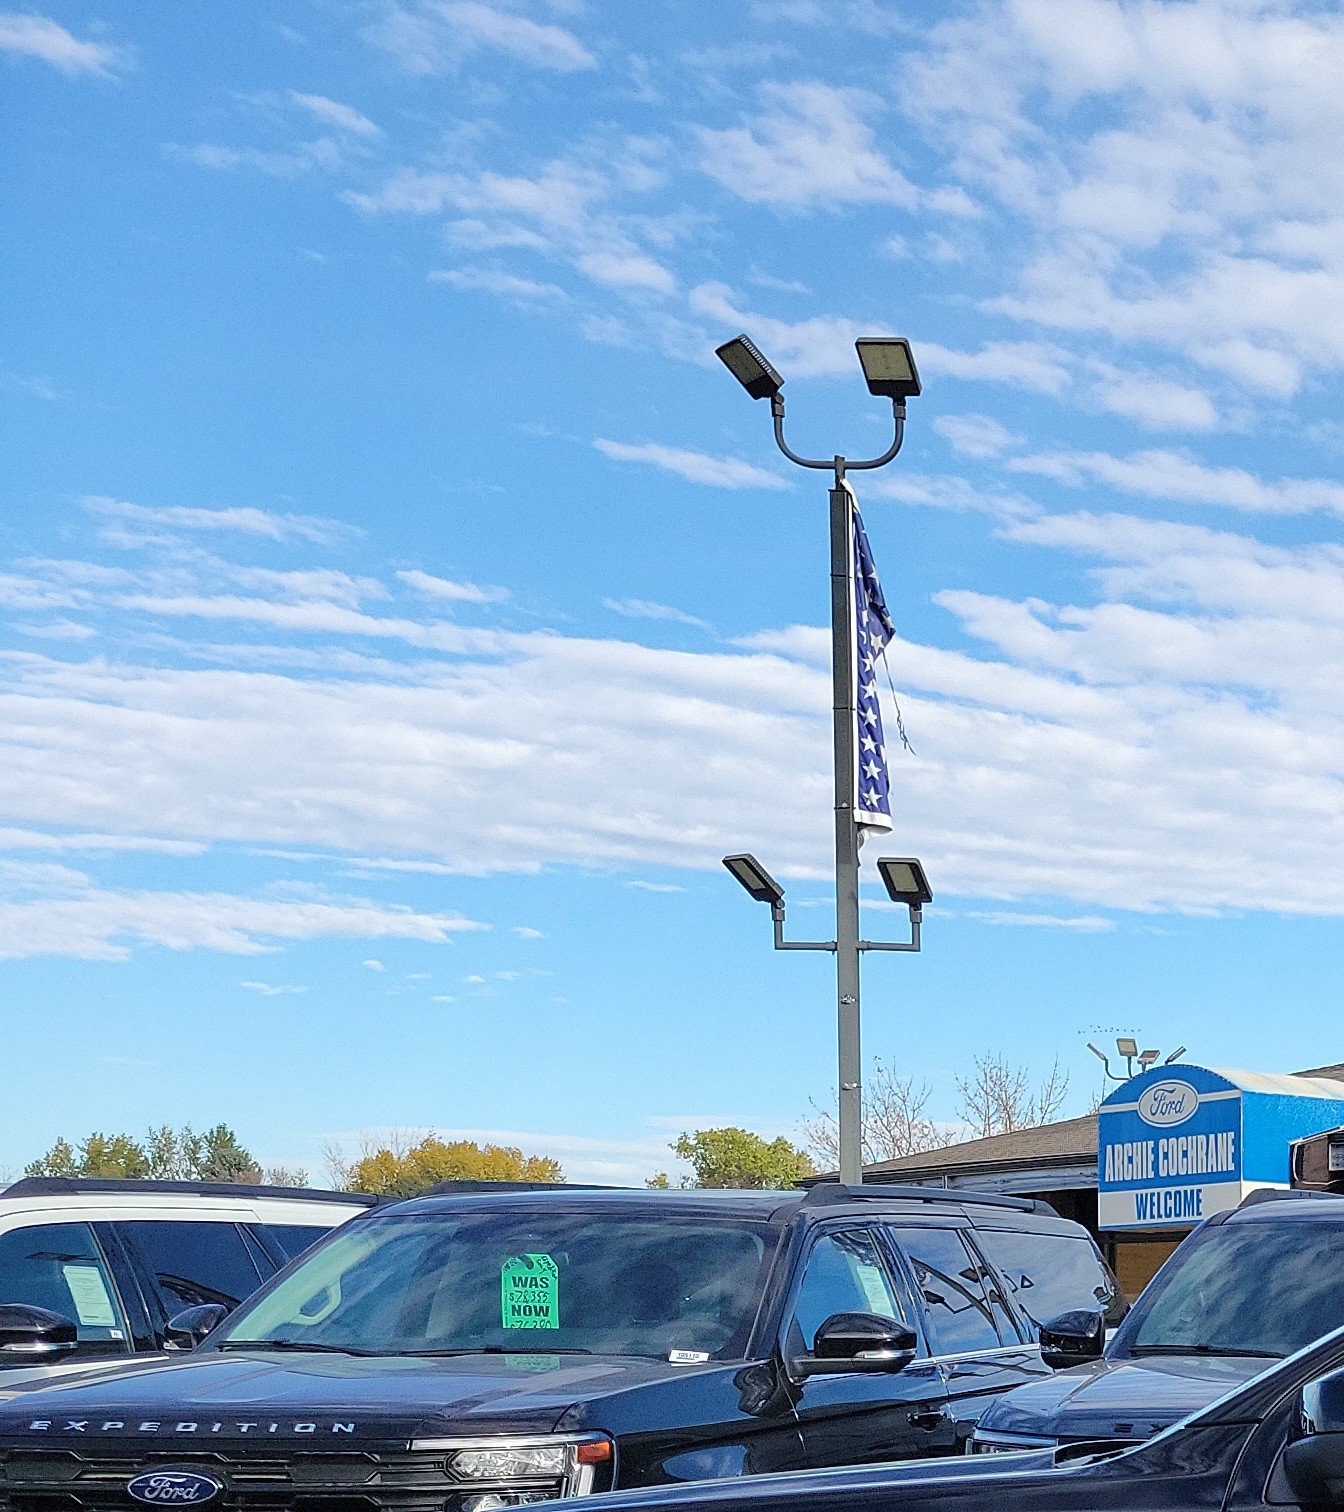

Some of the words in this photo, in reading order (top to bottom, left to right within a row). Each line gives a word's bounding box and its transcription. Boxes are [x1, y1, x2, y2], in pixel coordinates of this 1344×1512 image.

[1150, 1088, 1186, 1116] Ford
[1105, 1141, 1154, 1182] ARCHIE
[1158, 1132, 1235, 1177] COCHRANE
[1135, 1189, 1203, 1220] WELCOME
[512, 1276, 549, 1288] WAS
[511, 1305, 550, 1317] NOW
[28, 1420, 355, 1433] EXPEDITION
[144, 1476, 200, 1500] Ford
